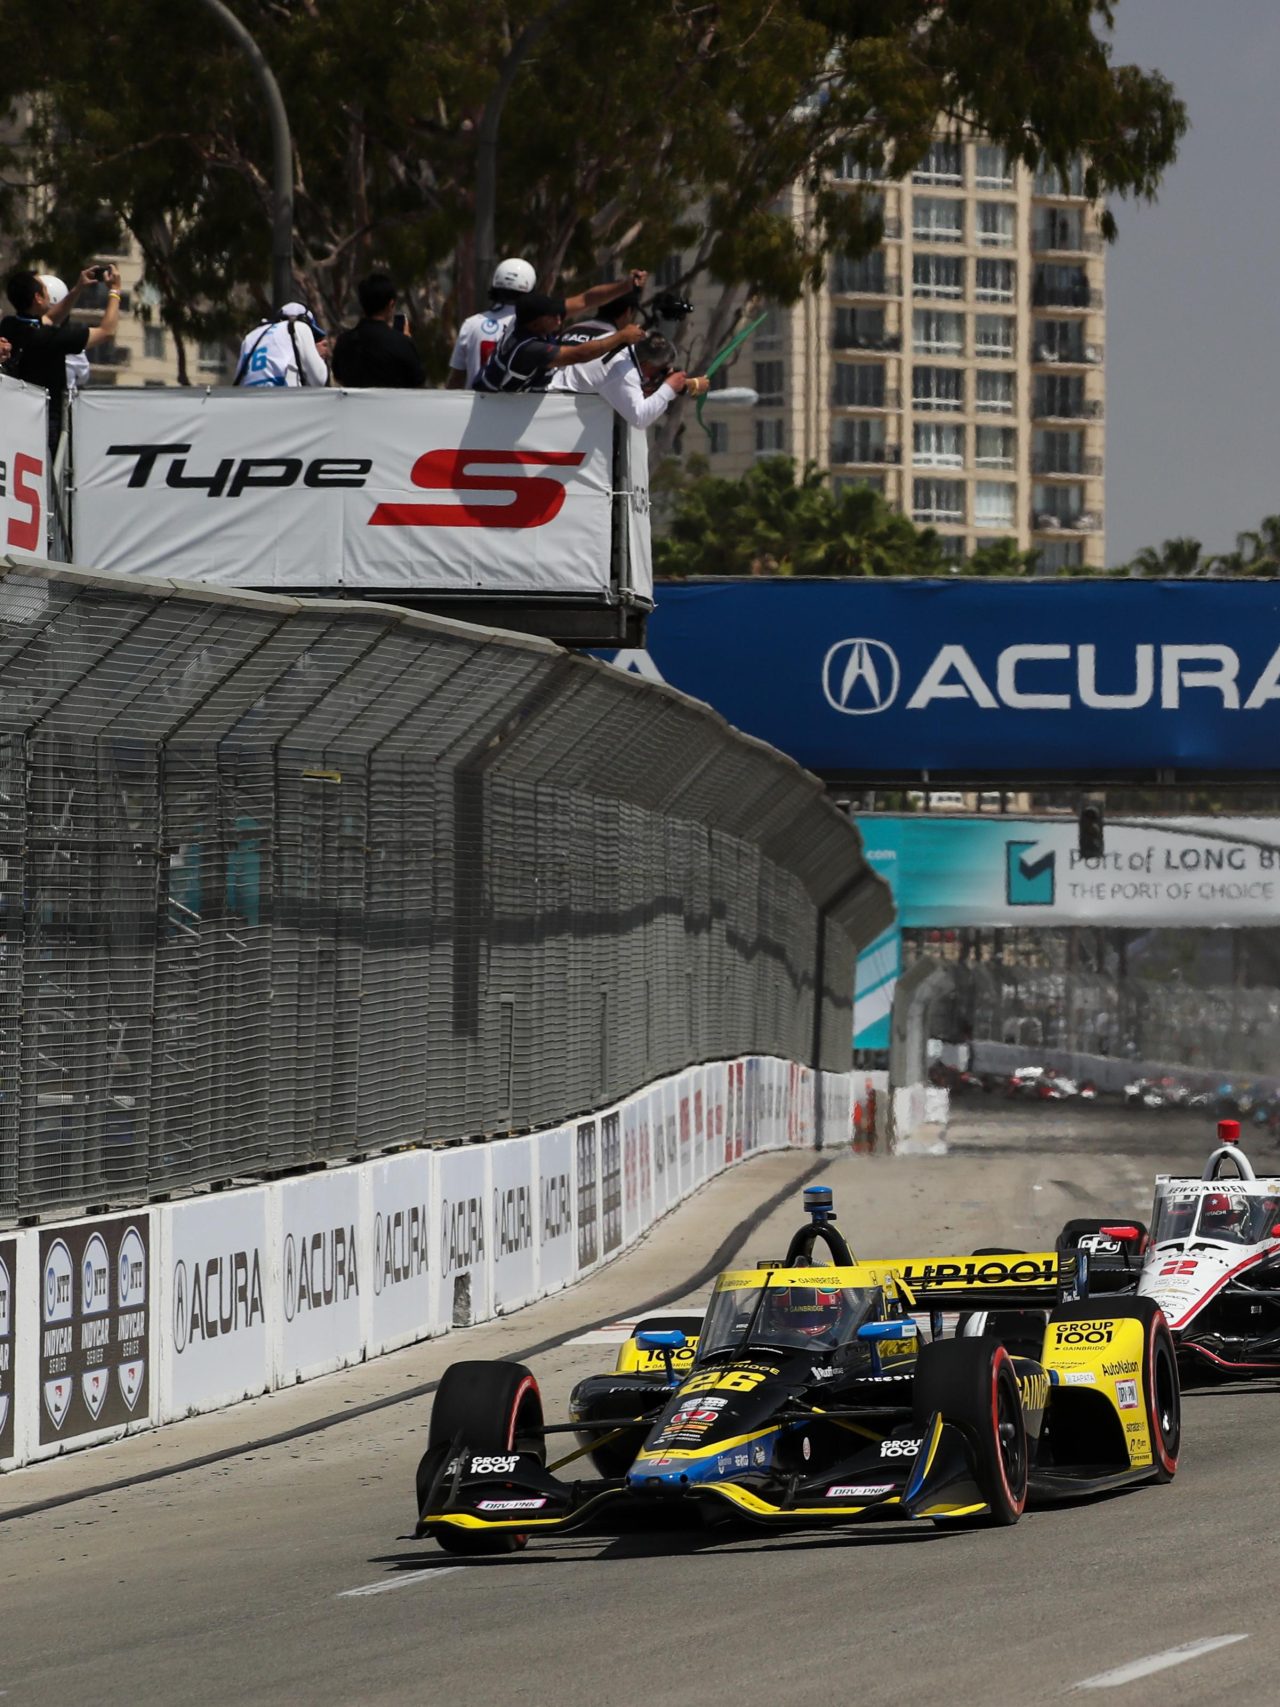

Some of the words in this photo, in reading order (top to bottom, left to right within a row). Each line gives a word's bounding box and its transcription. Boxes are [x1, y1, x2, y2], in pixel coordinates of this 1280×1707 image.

[106, 444, 373, 498] Type
[366, 449, 588, 529] S
[7, 452, 43, 552] S
[1128, 847, 1154, 873] of
[1164, 848, 1246, 871] LONG
[1068, 882, 1105, 900] THE
[1111, 882, 1161, 900] PORT
[1166, 882, 1192, 900] OF
[1199, 882, 1274, 900] CHOICE
[1168, 1185, 1247, 1194] NEWGARDEN
[500, 1185, 532, 1258] ACURA
[450, 1197, 485, 1271] ACURA
[383, 1204, 429, 1288] ACURA
[297, 1225, 359, 1314] ACURA
[1158, 1260, 1199, 1277] 2
[798, 1276, 842, 1285] GAINBRIDGE
[189, 1248, 264, 1344] ACURA
[81, 1318, 109, 1349] INDYCAR
[118, 1311, 145, 1341] INDYCAR
[1056, 1321, 1114, 1332] GROUP
[44, 1326, 72, 1357] INDYCAR
[1056, 1331, 1113, 1344] 1001
[86, 1349, 104, 1366] SERIES
[123, 1340, 139, 1357] SERIES
[49, 1356, 66, 1374] SERIES
[1101, 1360, 1139, 1376] AutoNation
[675, 1371, 767, 1398] 26
[880, 1447, 919, 1457] 100
[881, 1439, 923, 1448] GROU
[470, 1463, 516, 1473] 1001
[472, 1455, 520, 1464] GROUP
